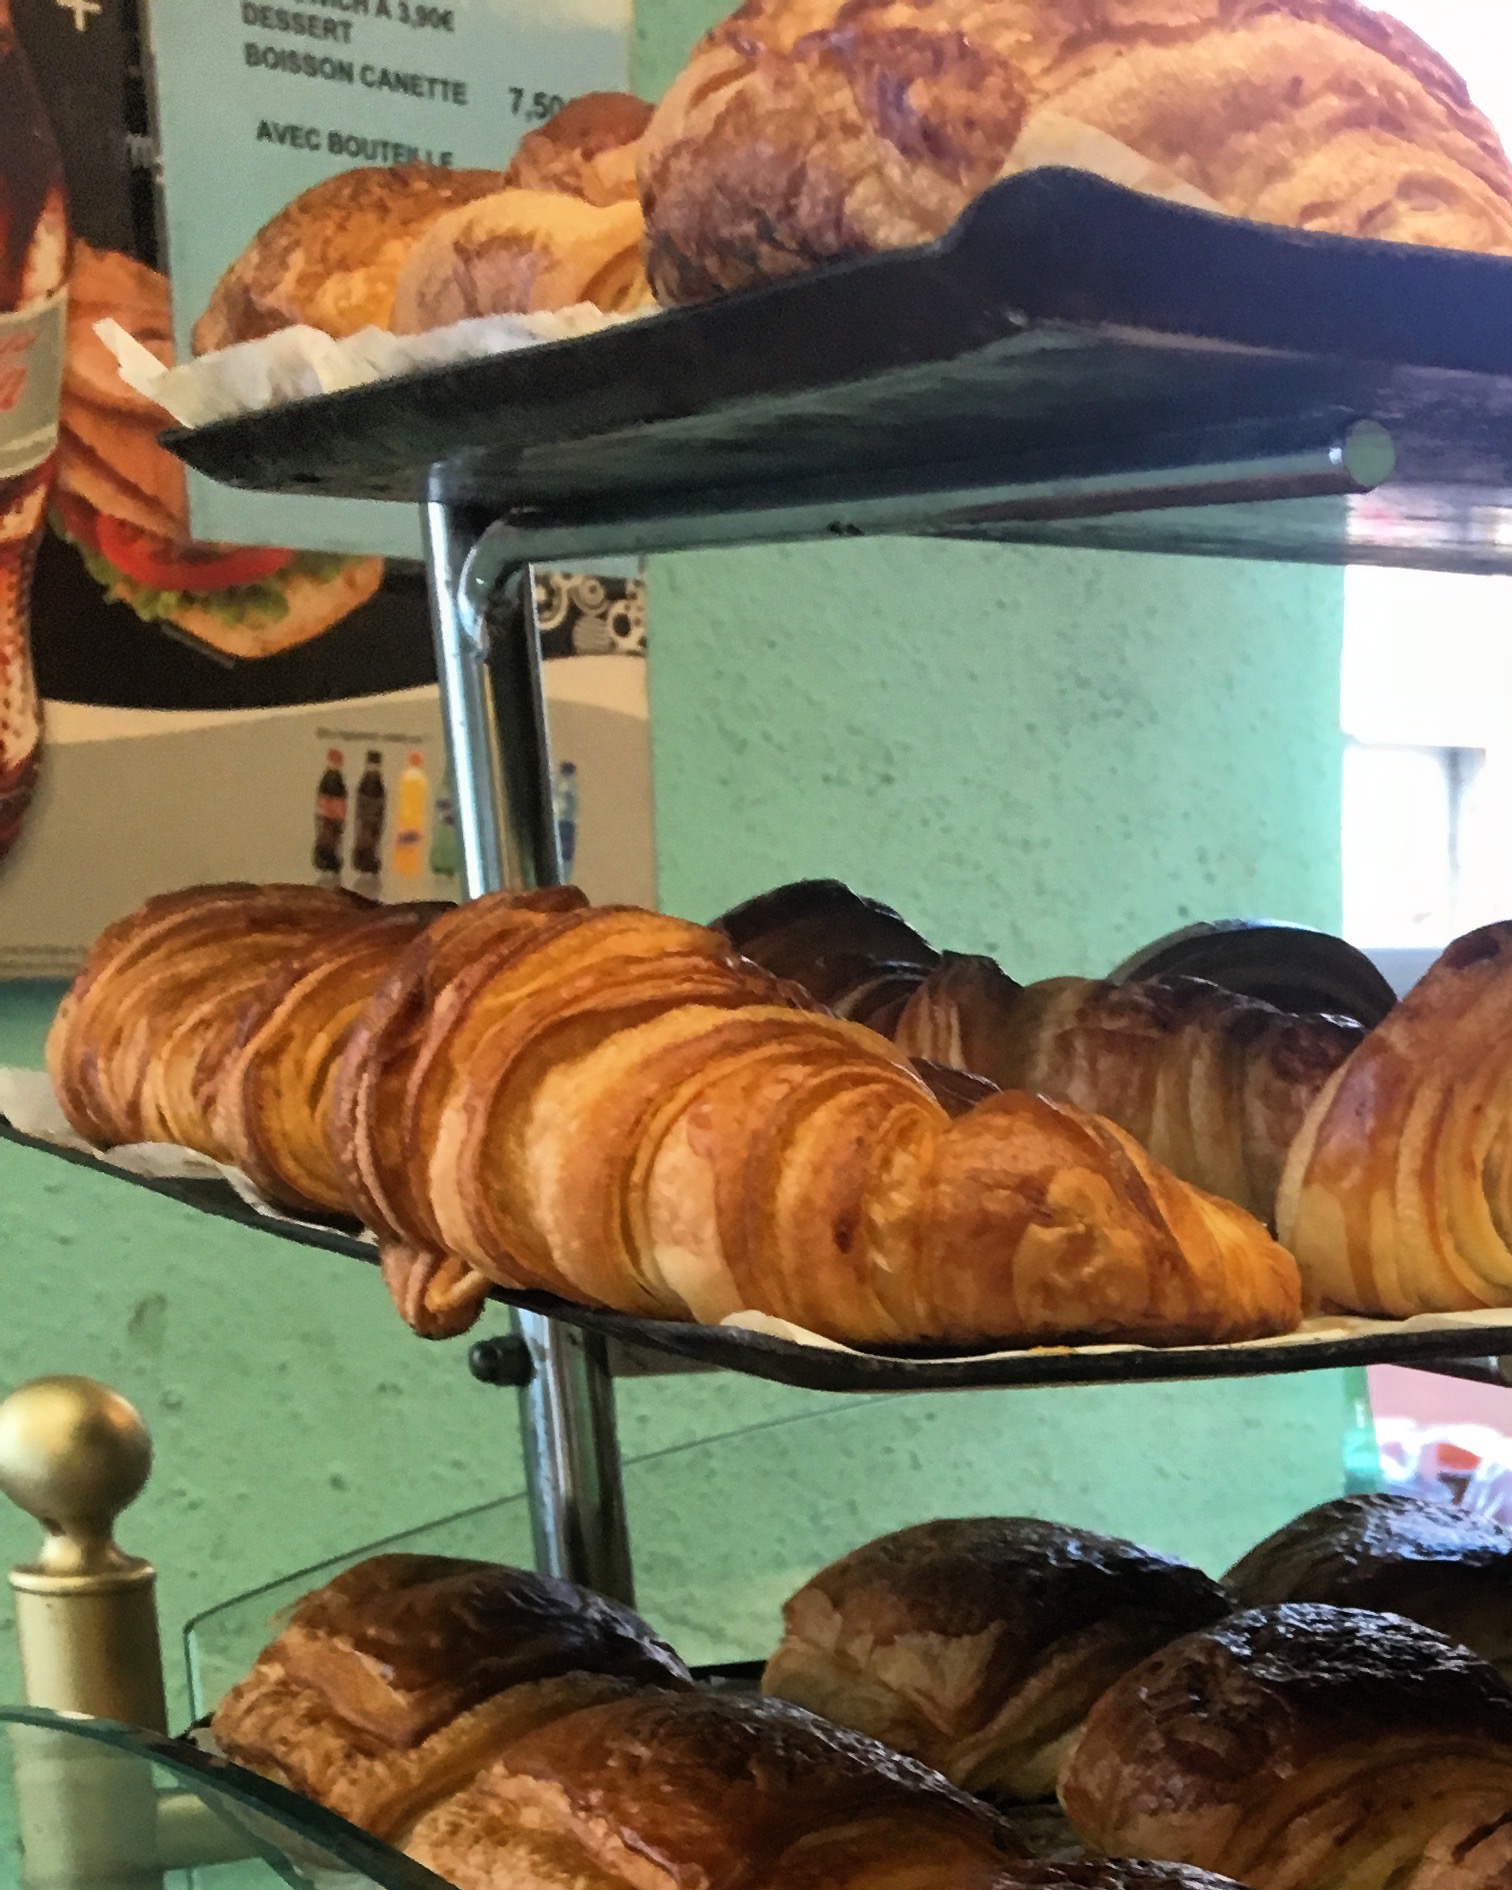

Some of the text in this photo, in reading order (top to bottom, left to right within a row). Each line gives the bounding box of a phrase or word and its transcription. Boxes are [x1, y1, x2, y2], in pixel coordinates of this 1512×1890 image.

[241, 1, 353, 44] DESSERT
[244, 42, 354, 84] BOISSON
[360, 64, 467, 106] CANETTE
[256, 119, 321, 151] AVEC
